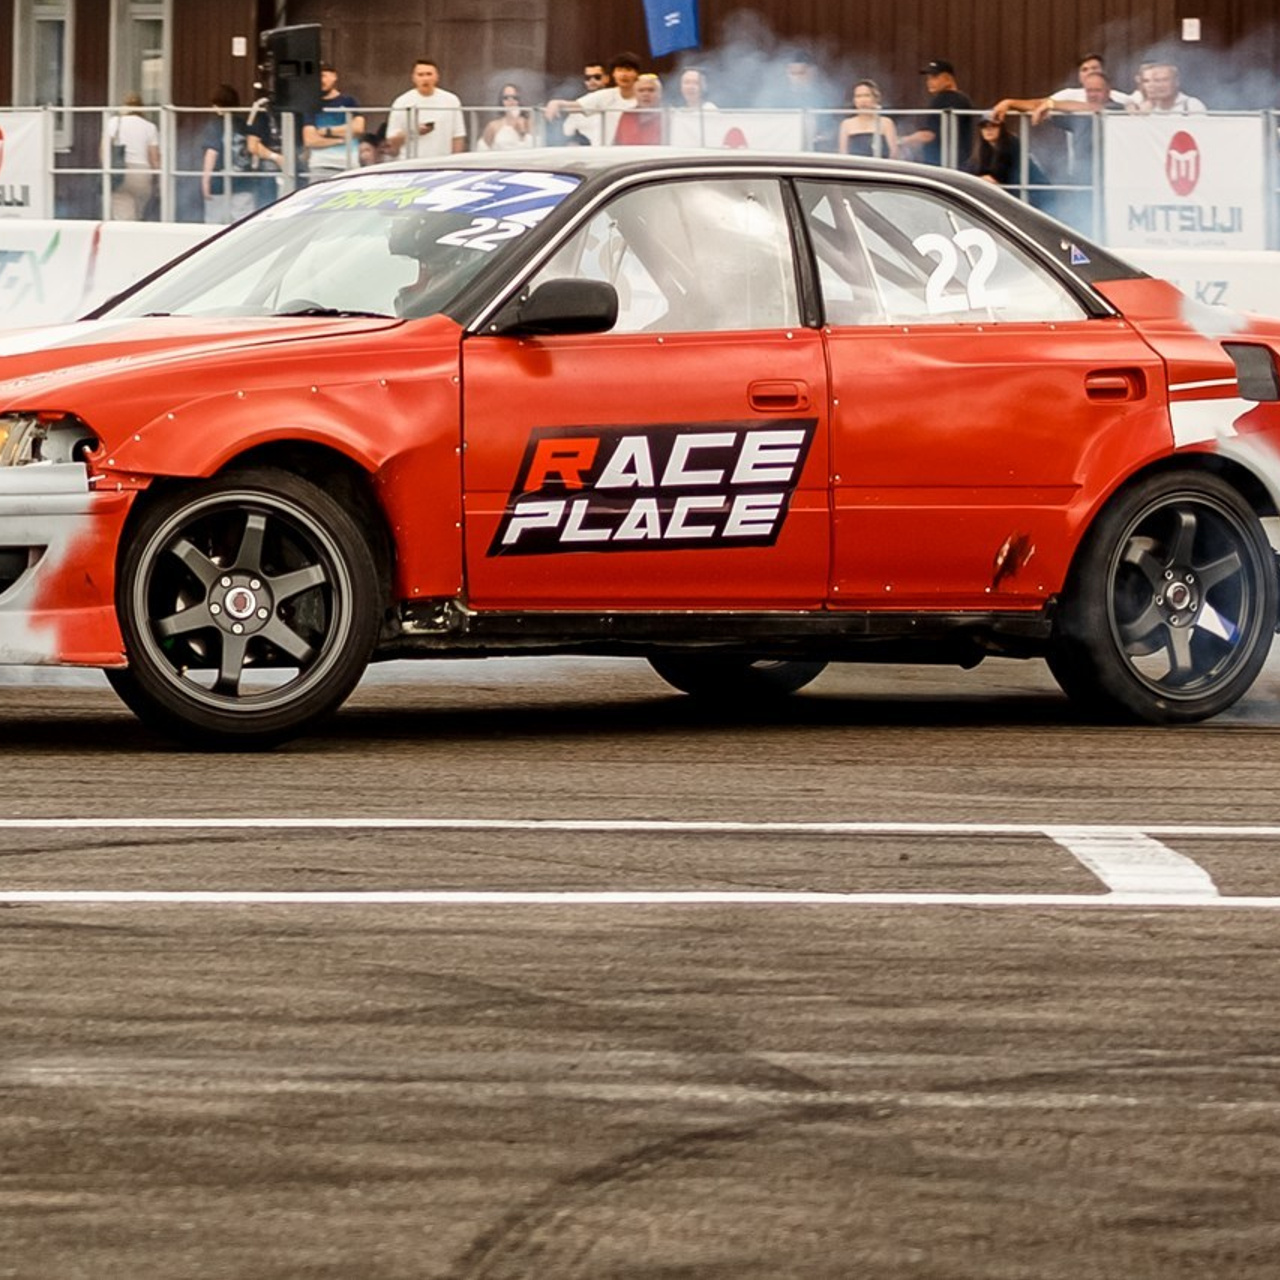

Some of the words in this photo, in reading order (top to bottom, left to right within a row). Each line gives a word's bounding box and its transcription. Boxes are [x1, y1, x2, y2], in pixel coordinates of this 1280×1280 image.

[435, 218, 526, 252] 22
[1127, 205, 1243, 233] MITSUJI
[912, 227, 1008, 314] 22
[523, 429, 806, 492] RACE
[501, 492, 784, 545] PLACE
